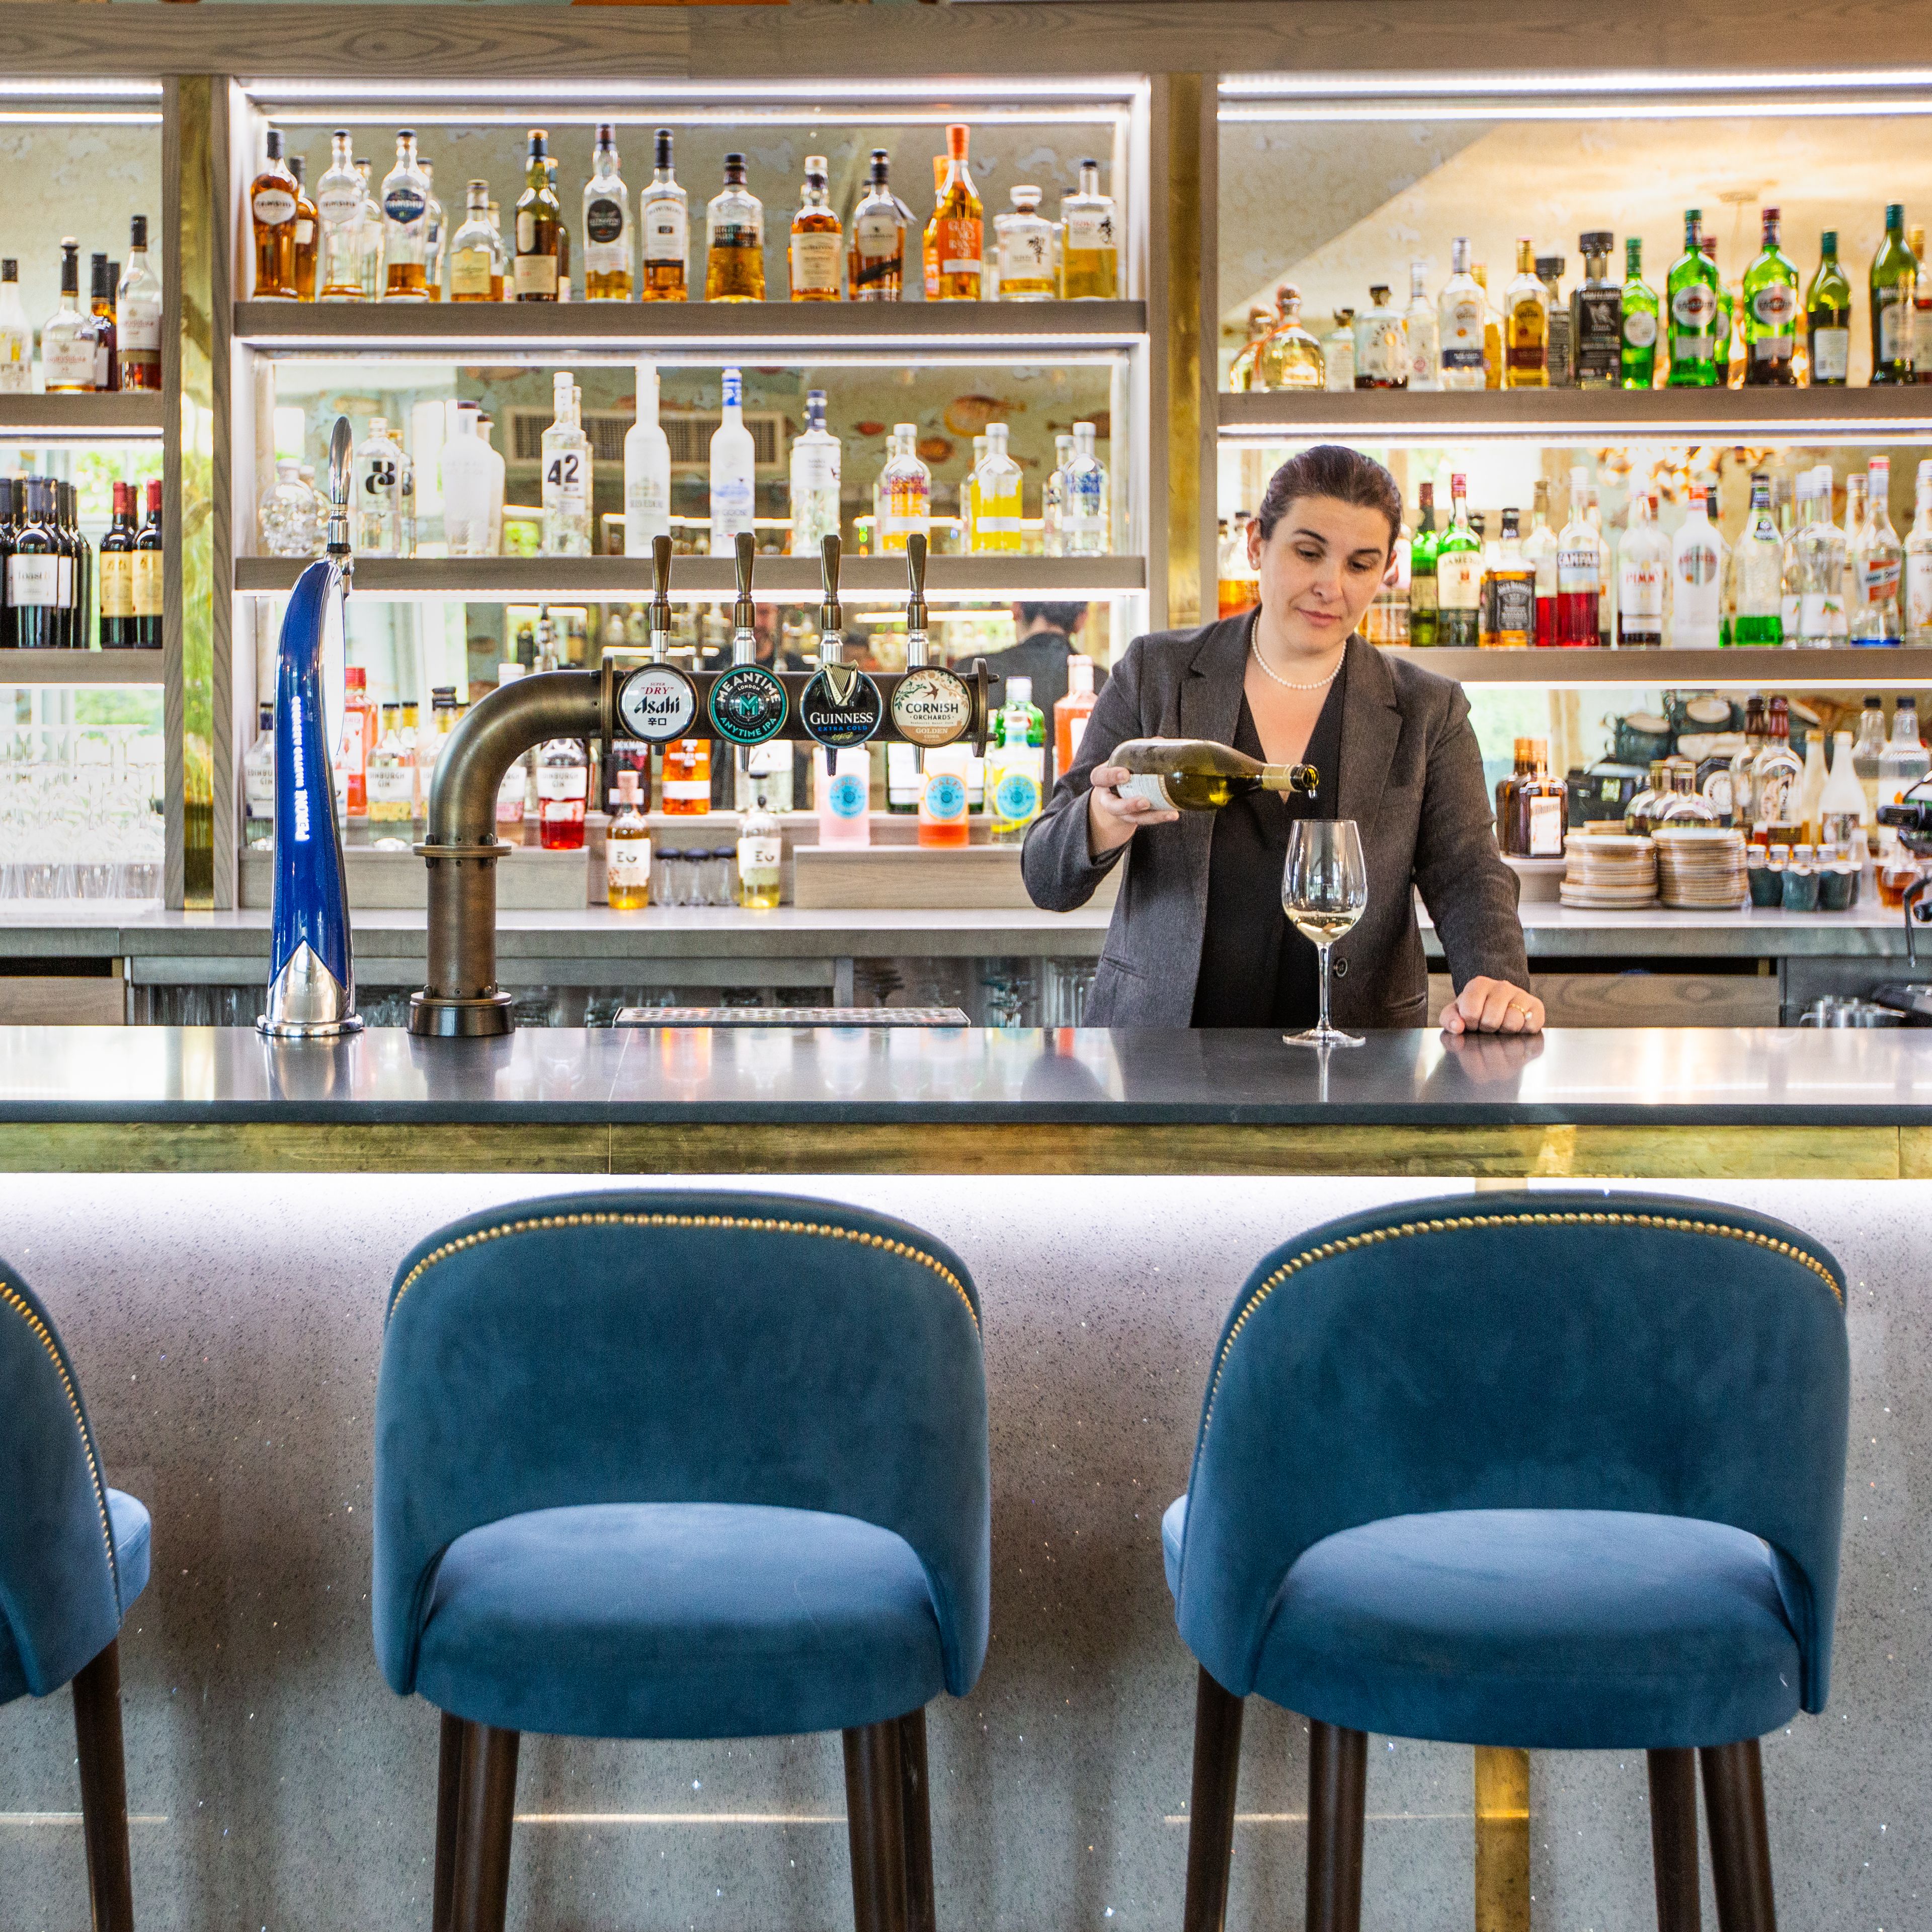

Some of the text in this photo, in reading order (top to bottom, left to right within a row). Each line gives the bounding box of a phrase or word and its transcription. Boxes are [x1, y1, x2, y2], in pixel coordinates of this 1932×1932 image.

[547, 454, 579, 486] 42
[716, 672, 781, 703] MEANTIME
[634, 695, 680, 714] Asahi
[906, 703, 958, 713] CORNISH
[648, 717, 667, 726] 辛口
[720, 717, 763, 737] ANYTIME
[763, 717, 777, 732] IPA
[810, 712, 873, 725] GUINNESS
[293, 746, 304, 788] NASTRO
[294, 789, 310, 841] PERONI
[616, 851, 637, 862] EG
[754, 850, 774, 862] EG
